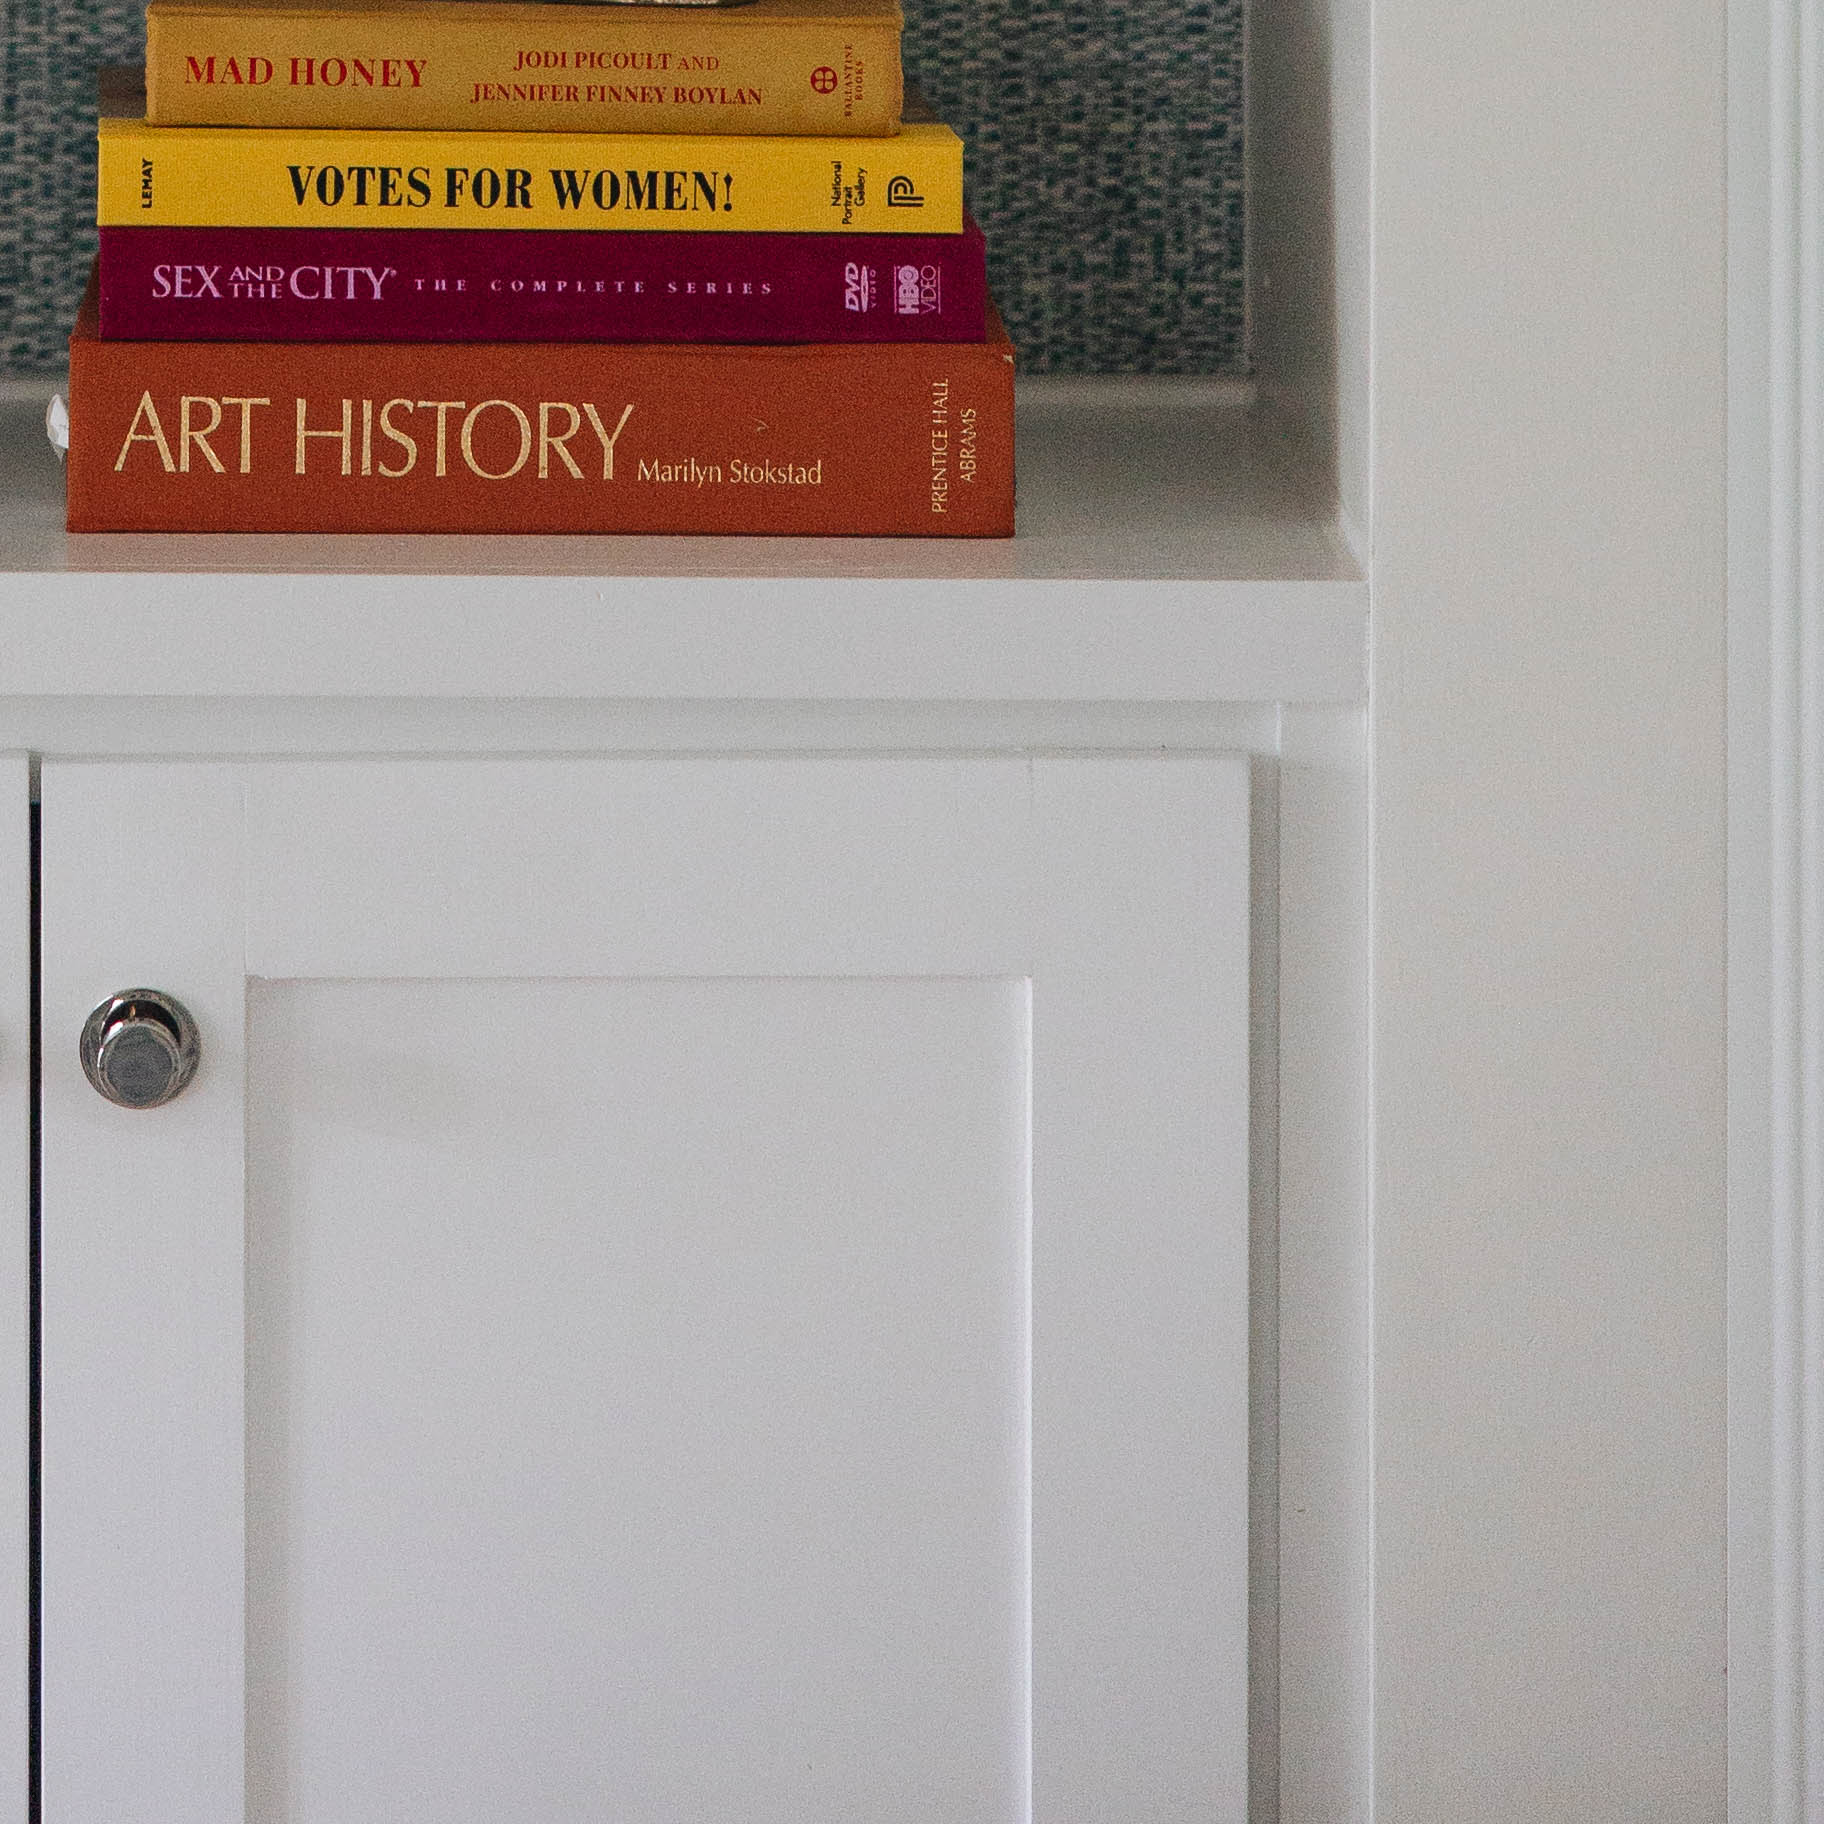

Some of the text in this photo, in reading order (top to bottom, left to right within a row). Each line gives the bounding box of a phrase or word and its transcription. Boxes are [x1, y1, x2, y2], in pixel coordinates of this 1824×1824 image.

[185, 56, 427, 88] MAD HONEY
[514, 50, 720, 71] JODI PICOULT AND
[855, 60, 864, 100] BOOKS
[470, 83, 763, 106] JENNIFER FINNEY BOYLAN
[141, 158, 154, 209] LEMAY
[287, 165, 734, 212] VOTES FOR WOMEN!
[831, 161, 842, 206] National
[854, 168, 868, 206] Gallery
[842, 186, 853, 225] Portrait
[152, 264, 390, 300] SEX AND THE CITY
[415, 278, 773, 295] THE COMPLETE SERIES
[845, 262, 860, 312] DVD
[898, 264, 920, 314] HBO
[920, 264, 937, 315] VIDEO
[114, 390, 635, 480] ART HISTORY
[931, 378, 949, 514] PRENTICE HALL
[961, 407, 976, 484] ABRAMS
[637, 457, 822, 486] Marilyn Stokstad
